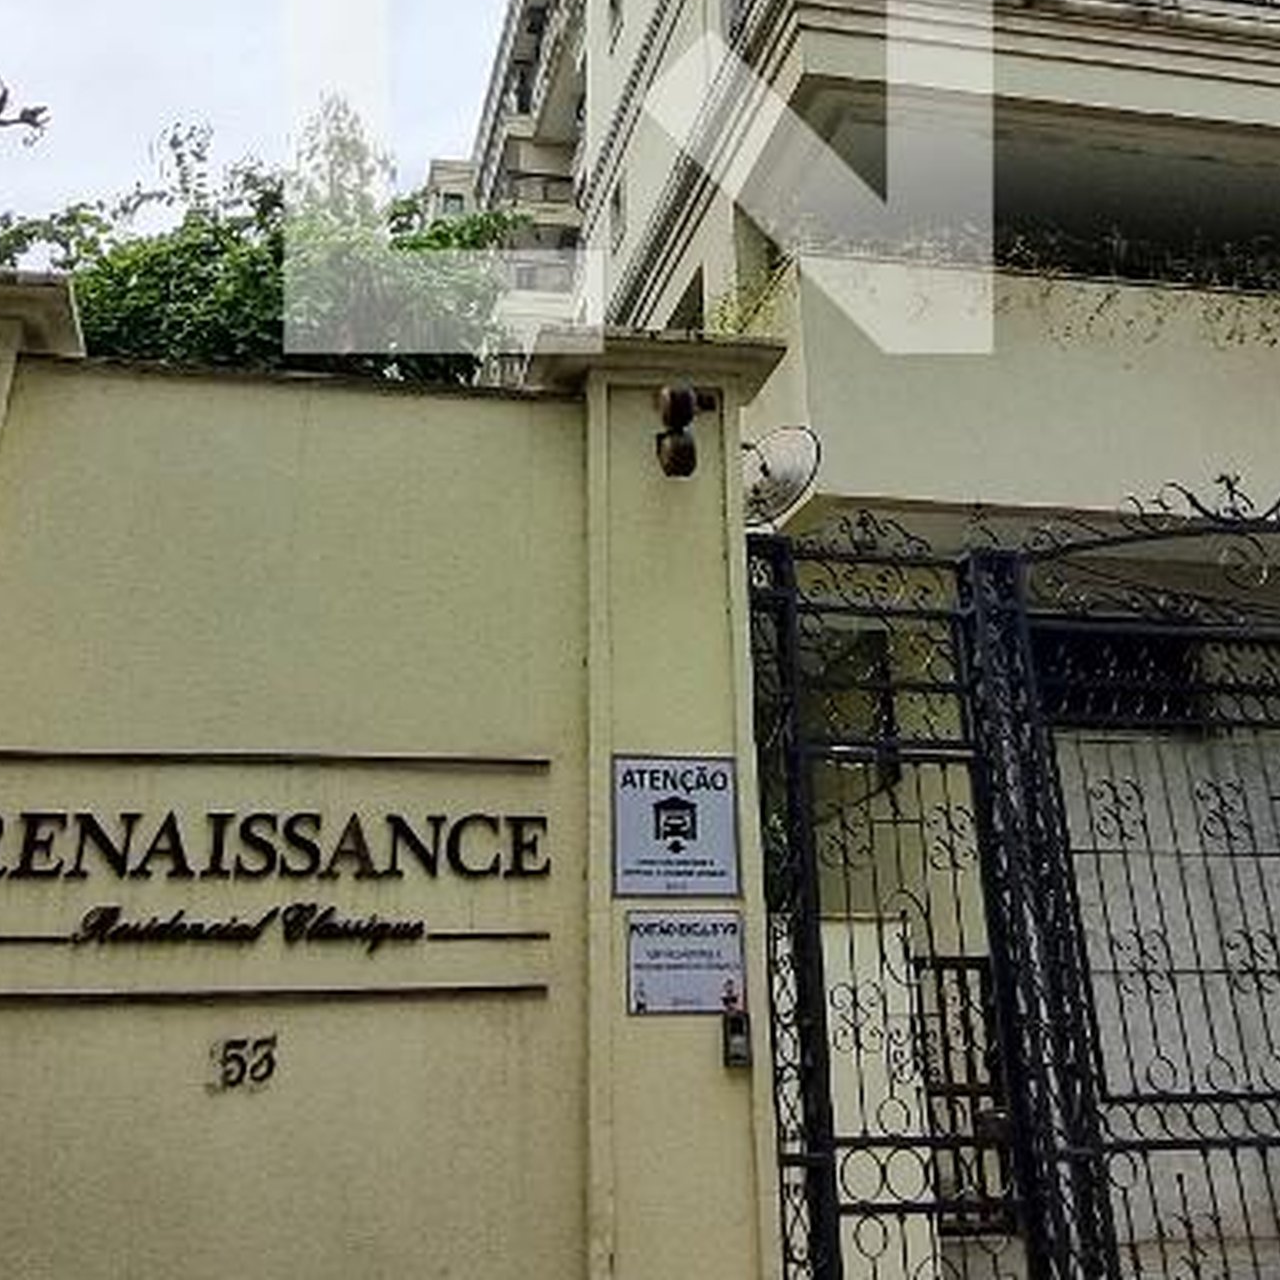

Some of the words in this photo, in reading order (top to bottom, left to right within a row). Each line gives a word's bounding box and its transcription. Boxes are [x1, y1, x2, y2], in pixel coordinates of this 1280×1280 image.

[621, 766, 728, 794] ATENÇÃO
[72, 906, 279, 946] Residencial
[281, 903, 426, 955] Classique
[221, 1034, 278, 1088] 53
